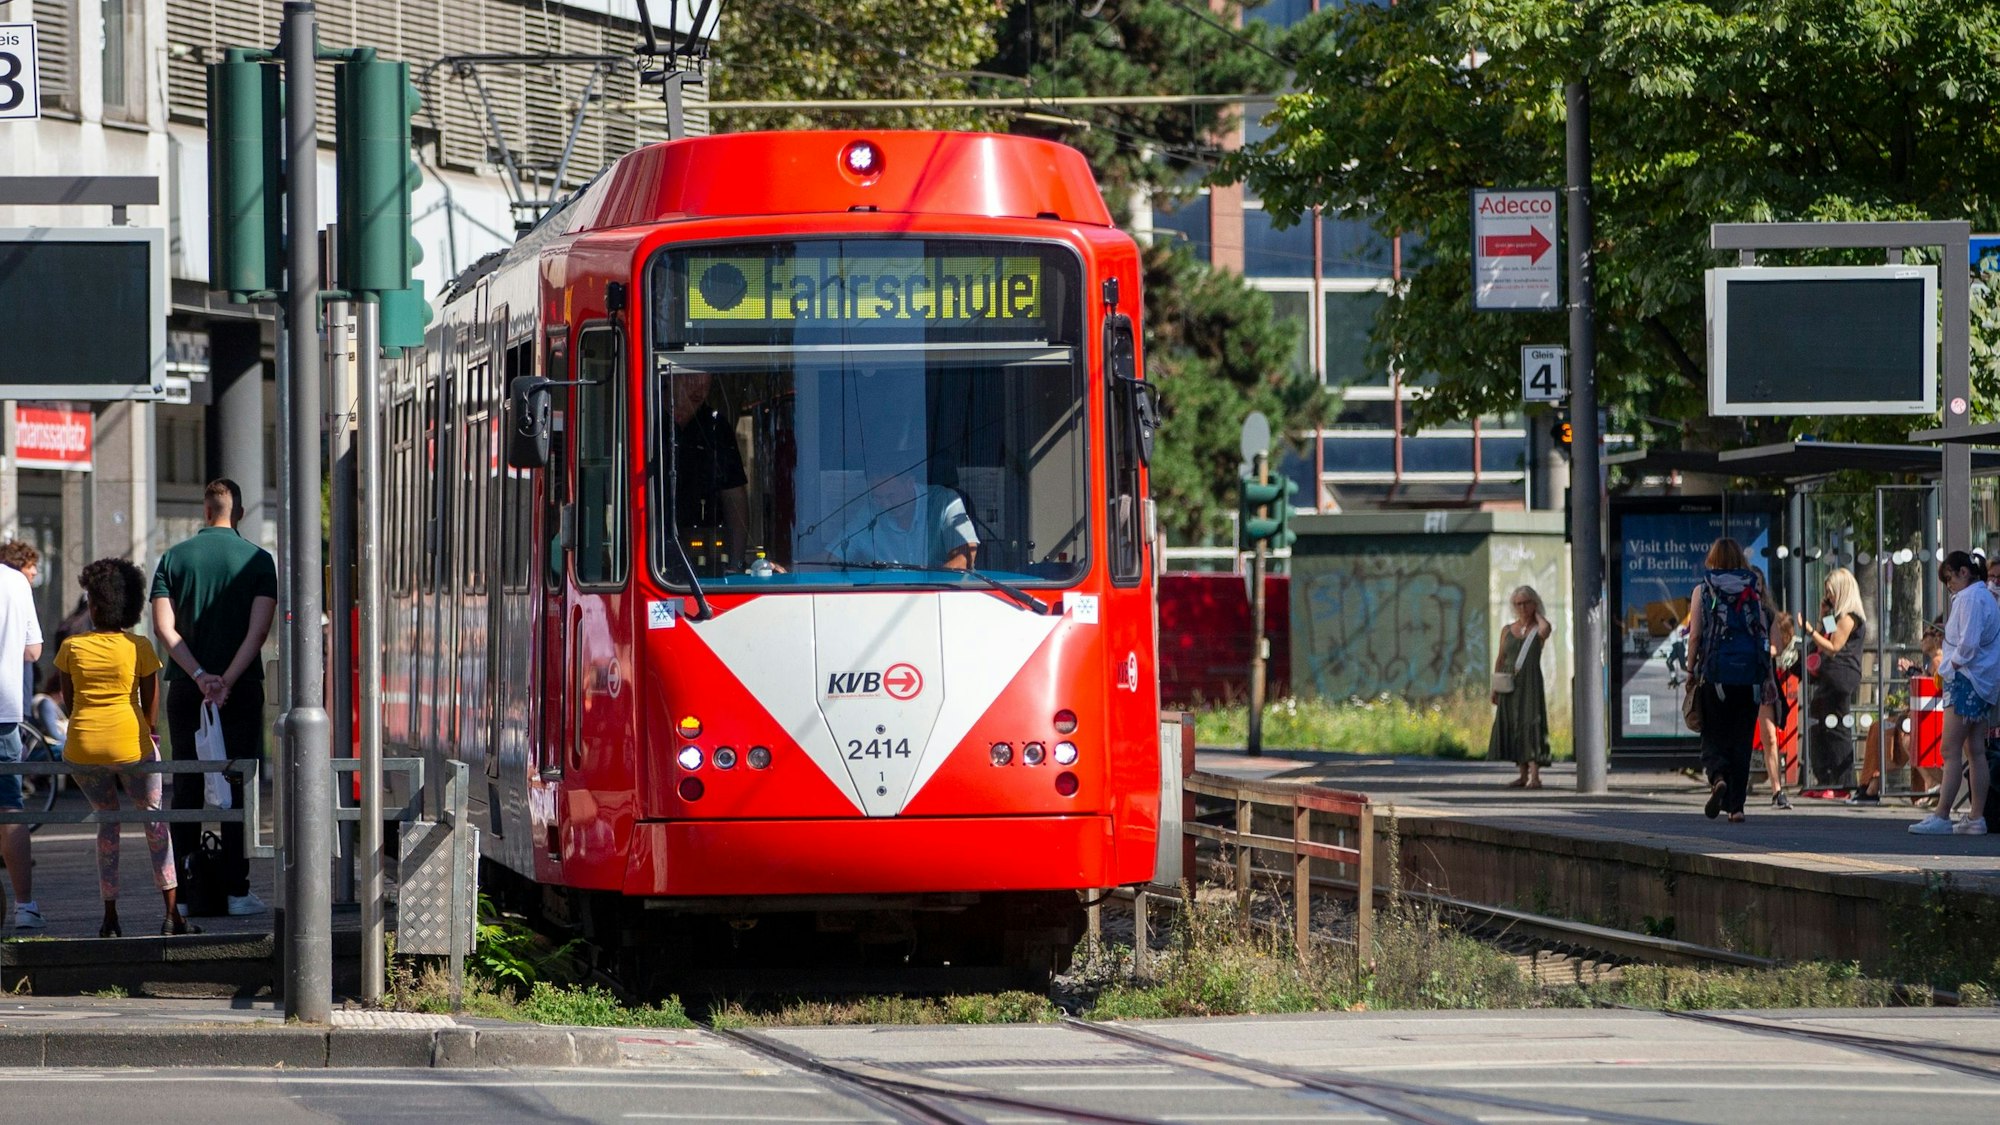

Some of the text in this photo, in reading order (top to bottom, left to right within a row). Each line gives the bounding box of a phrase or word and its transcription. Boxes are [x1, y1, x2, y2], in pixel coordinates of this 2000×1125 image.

[1478, 195, 1552, 215] Adecco
[765, 257, 1034, 319] Fahrschule
[1531, 350, 1554, 360] Gleis
[1530, 364, 1557, 396] 4
[1628, 538, 1661, 553] Visit
[1664, 538, 1686, 553] the
[1629, 556, 1693, 571] of Berlin.
[828, 672, 882, 694] KVB
[848, 738, 912, 760] 2414
[879, 771, 885, 782] 1
